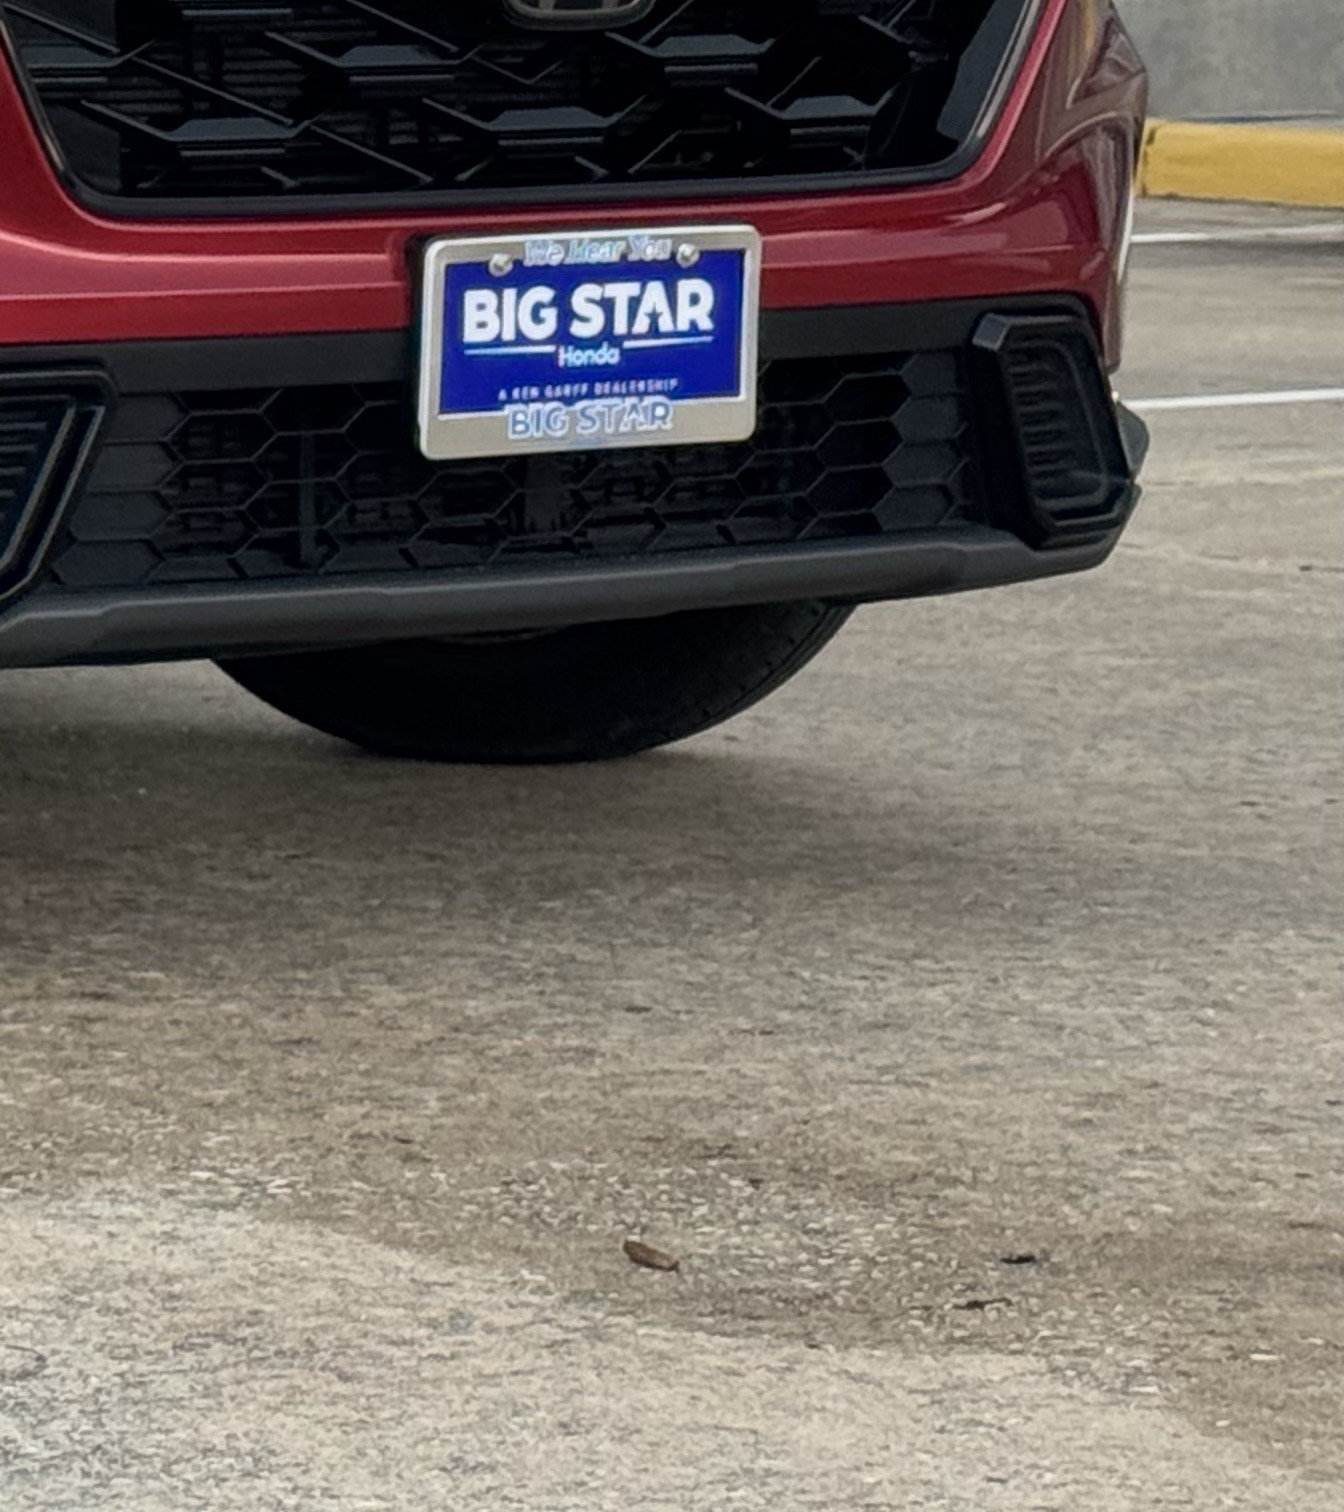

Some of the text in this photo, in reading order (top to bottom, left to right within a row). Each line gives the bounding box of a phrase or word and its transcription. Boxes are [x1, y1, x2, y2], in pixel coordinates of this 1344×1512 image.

[463, 278, 714, 344] BIG STAR
[558, 341, 620, 368] Honda
[593, 377, 679, 396] DEALERSHIP
[508, 396, 674, 438] BIG STAR
